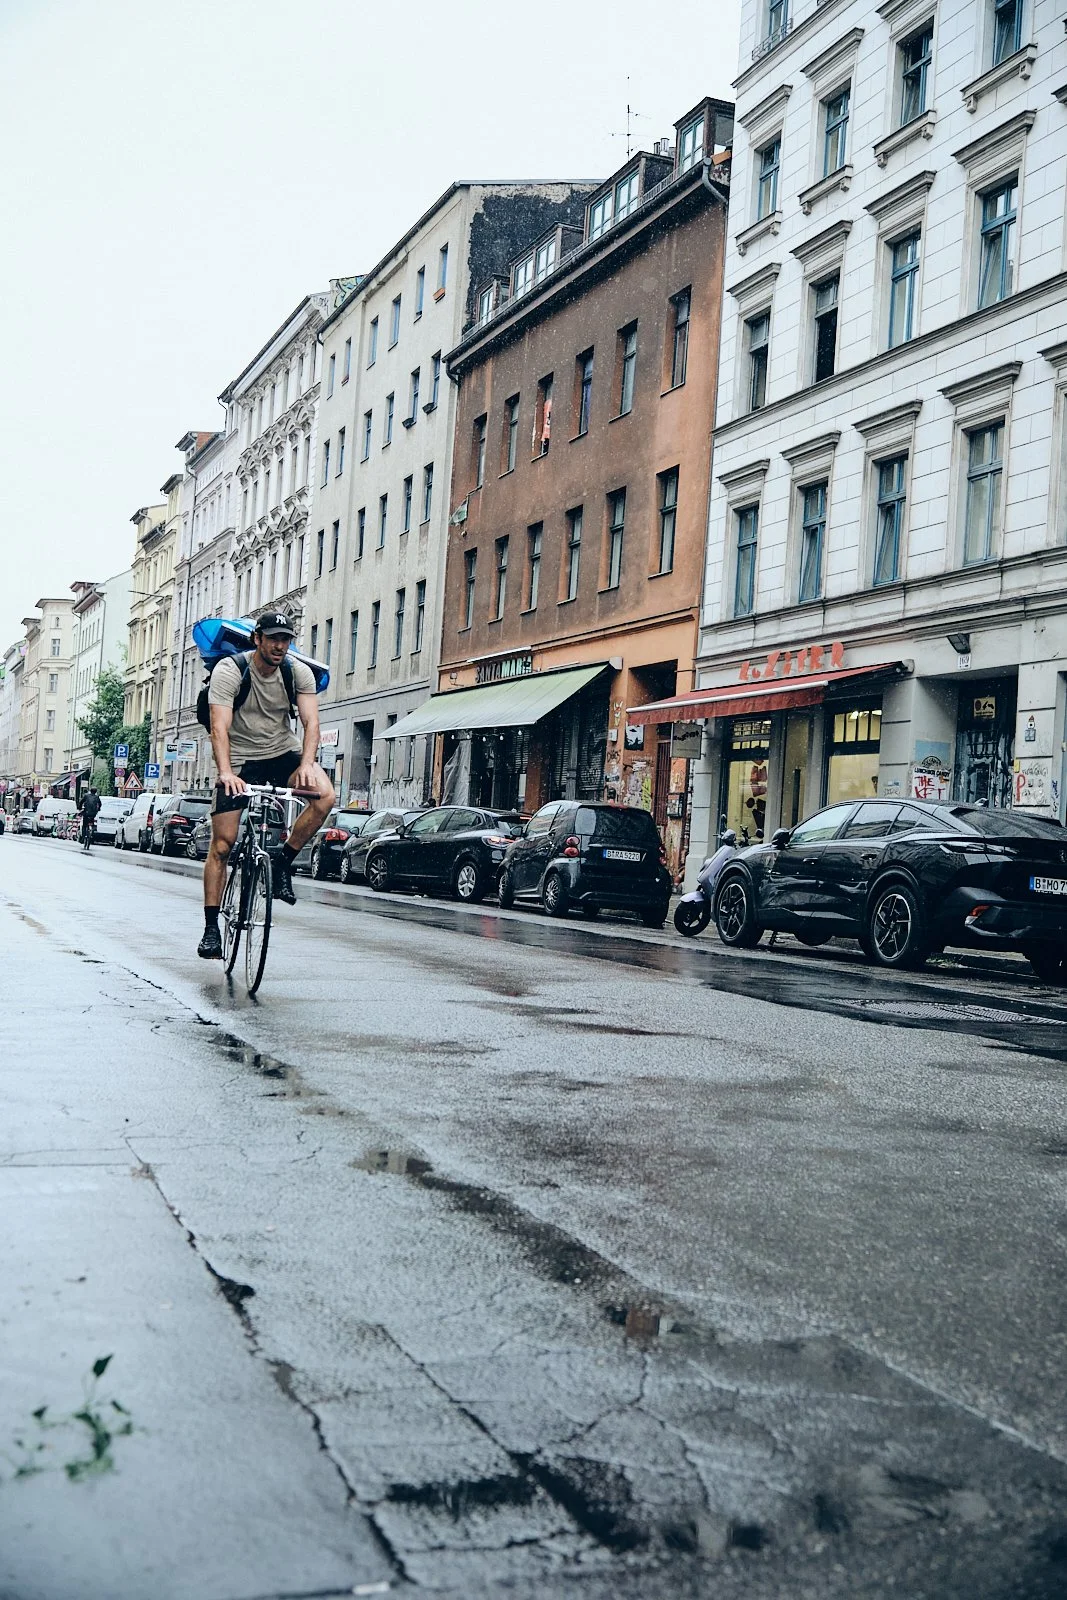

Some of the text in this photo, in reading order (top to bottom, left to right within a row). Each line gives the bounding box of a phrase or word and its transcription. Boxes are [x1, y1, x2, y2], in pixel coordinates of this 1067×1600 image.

[117, 746, 126, 757] P
[147, 764, 157, 777] P
[1036, 878, 1041, 888] B
[1047, 880, 1058, 890] MO
